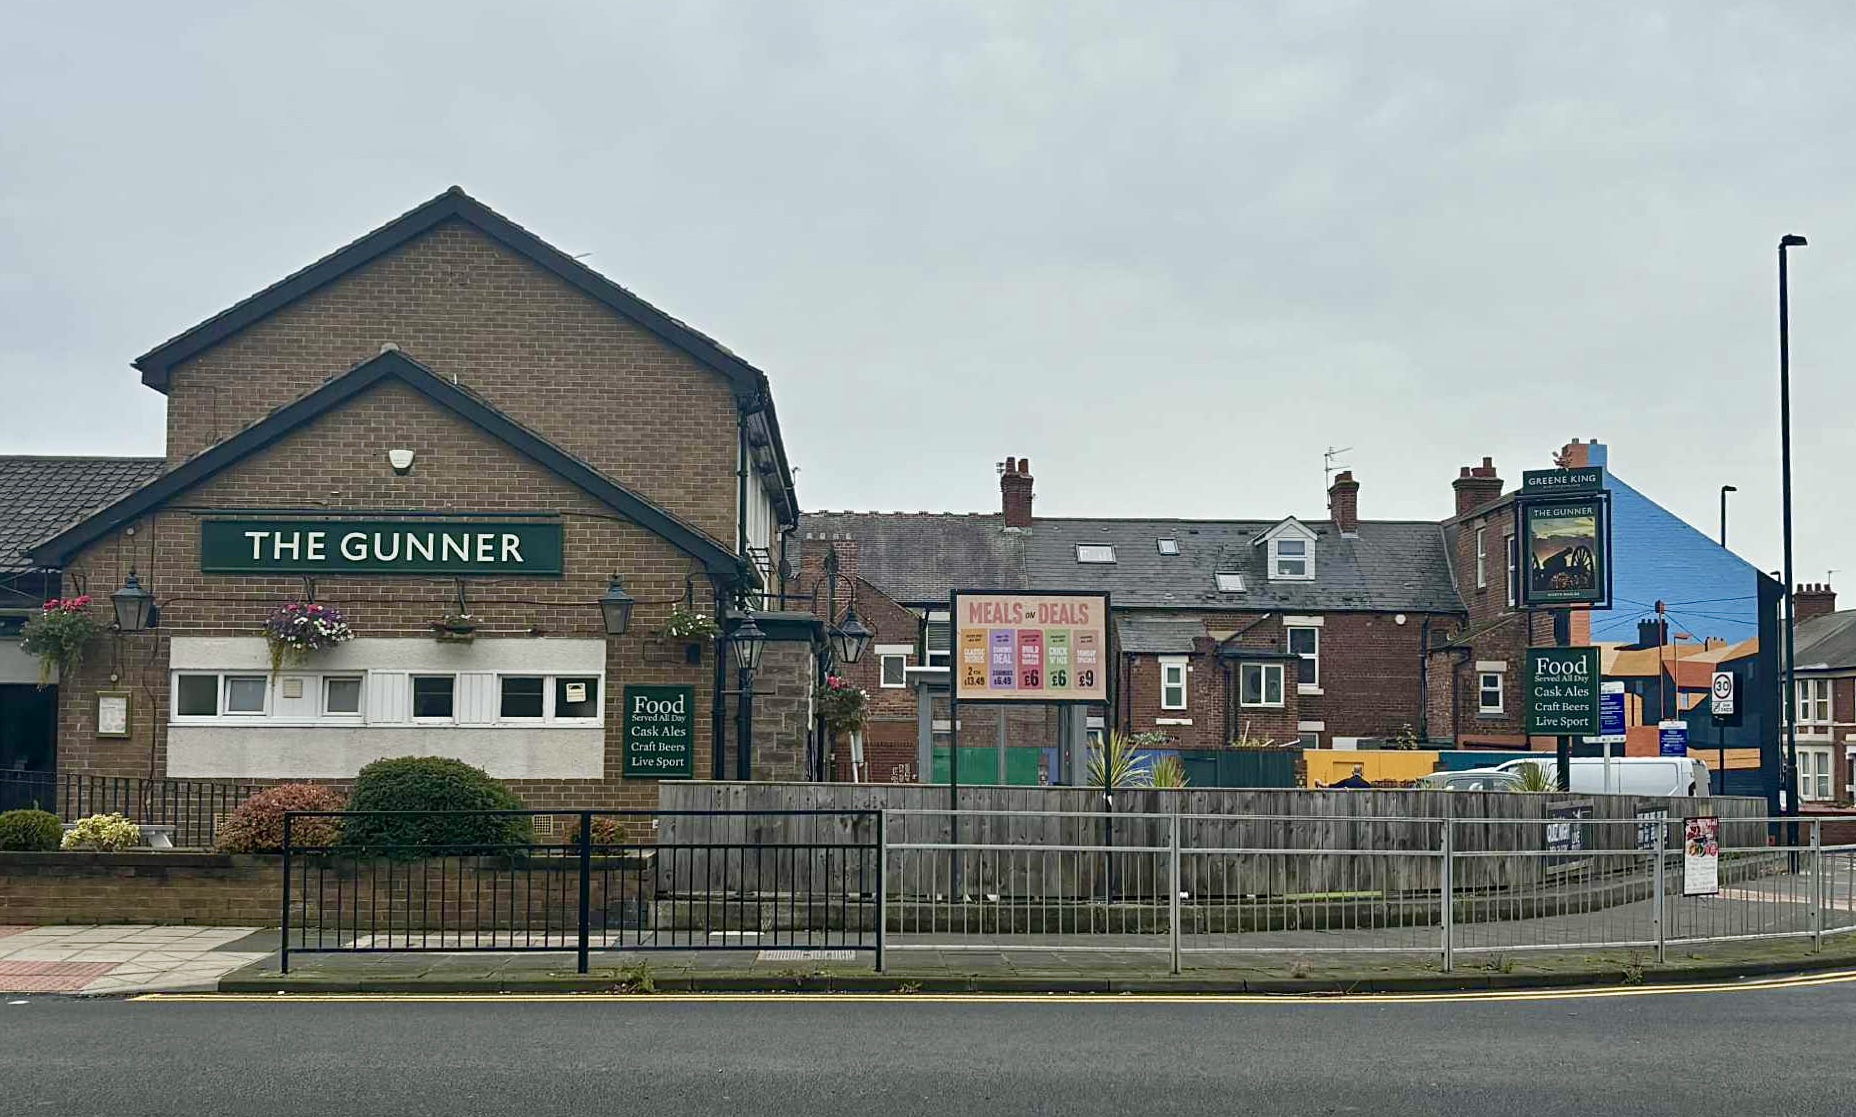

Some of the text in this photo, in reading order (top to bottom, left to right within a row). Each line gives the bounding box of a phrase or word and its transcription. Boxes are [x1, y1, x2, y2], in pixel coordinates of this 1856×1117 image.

[1528, 474, 1596, 486] GREENE KING
[1534, 507, 1593, 517] THE GUNNER
[245, 531, 524, 562] THE GUNNER
[969, 602, 1022, 624] MEALS
[1038, 603, 1089, 624] DEALS
[993, 653, 1012, 664] DEAL
[1536, 655, 1588, 675] Food
[968, 667, 972, 675] 2
[964, 677, 985, 686] £13.49
[1025, 670, 1039, 686] £6
[1052, 670, 1067, 686] £6
[1079, 670, 1093, 687] £9
[1574, 675, 1589, 683] Day
[1534, 686, 1589, 697] Cask Ales
[1716, 681, 1729, 691] 30
[633, 694, 685, 714] Food
[1535, 702, 1589, 712] Craft Beers
[632, 714, 686, 723] Served All Day
[1536, 717, 1588, 728] Live Sport
[631, 726, 686, 736] Cask Ales
[631, 742, 685, 752] Craft Beers
[632, 757, 684, 768] Live Sport
